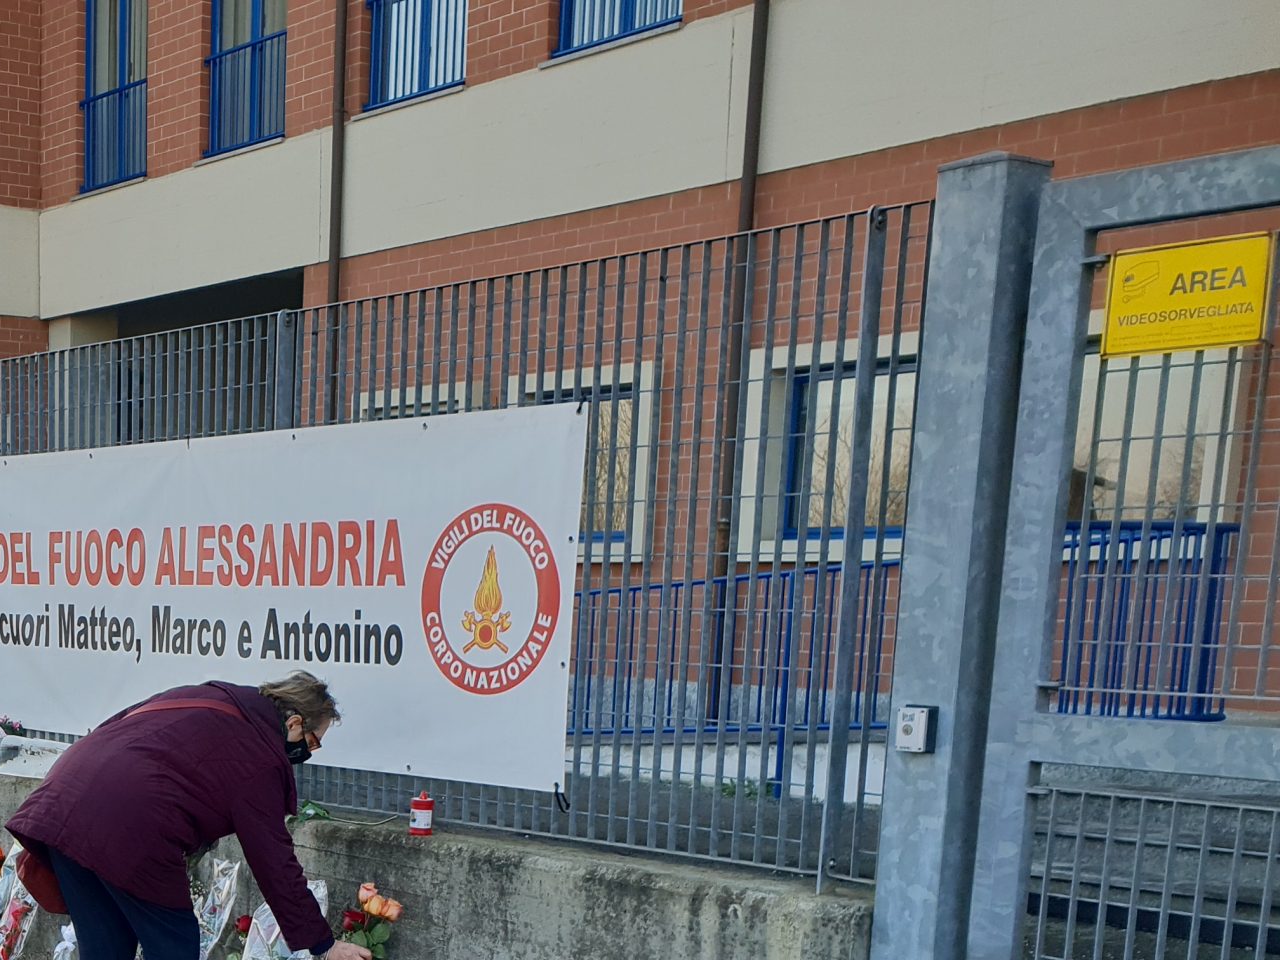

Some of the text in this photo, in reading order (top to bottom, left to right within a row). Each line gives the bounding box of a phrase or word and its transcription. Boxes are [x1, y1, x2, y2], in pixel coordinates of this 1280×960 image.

[1169, 265, 1247, 296] AREA
[1117, 302, 1255, 327] VIDEOSORVEGLIATA
[49, 527, 146, 587] FUOCO
[154, 518, 407, 588] ALESSANDRIA
[431, 509, 549, 571] VIGILI DEL FUOCO
[0, 603, 51, 648] cuori
[58, 603, 142, 664] Matteo,
[151, 604, 227, 658] Marco
[237, 619, 252, 657] e
[260, 607, 404, 667] Antonino
[426, 611, 552, 690] CORPO NAZIONALE
